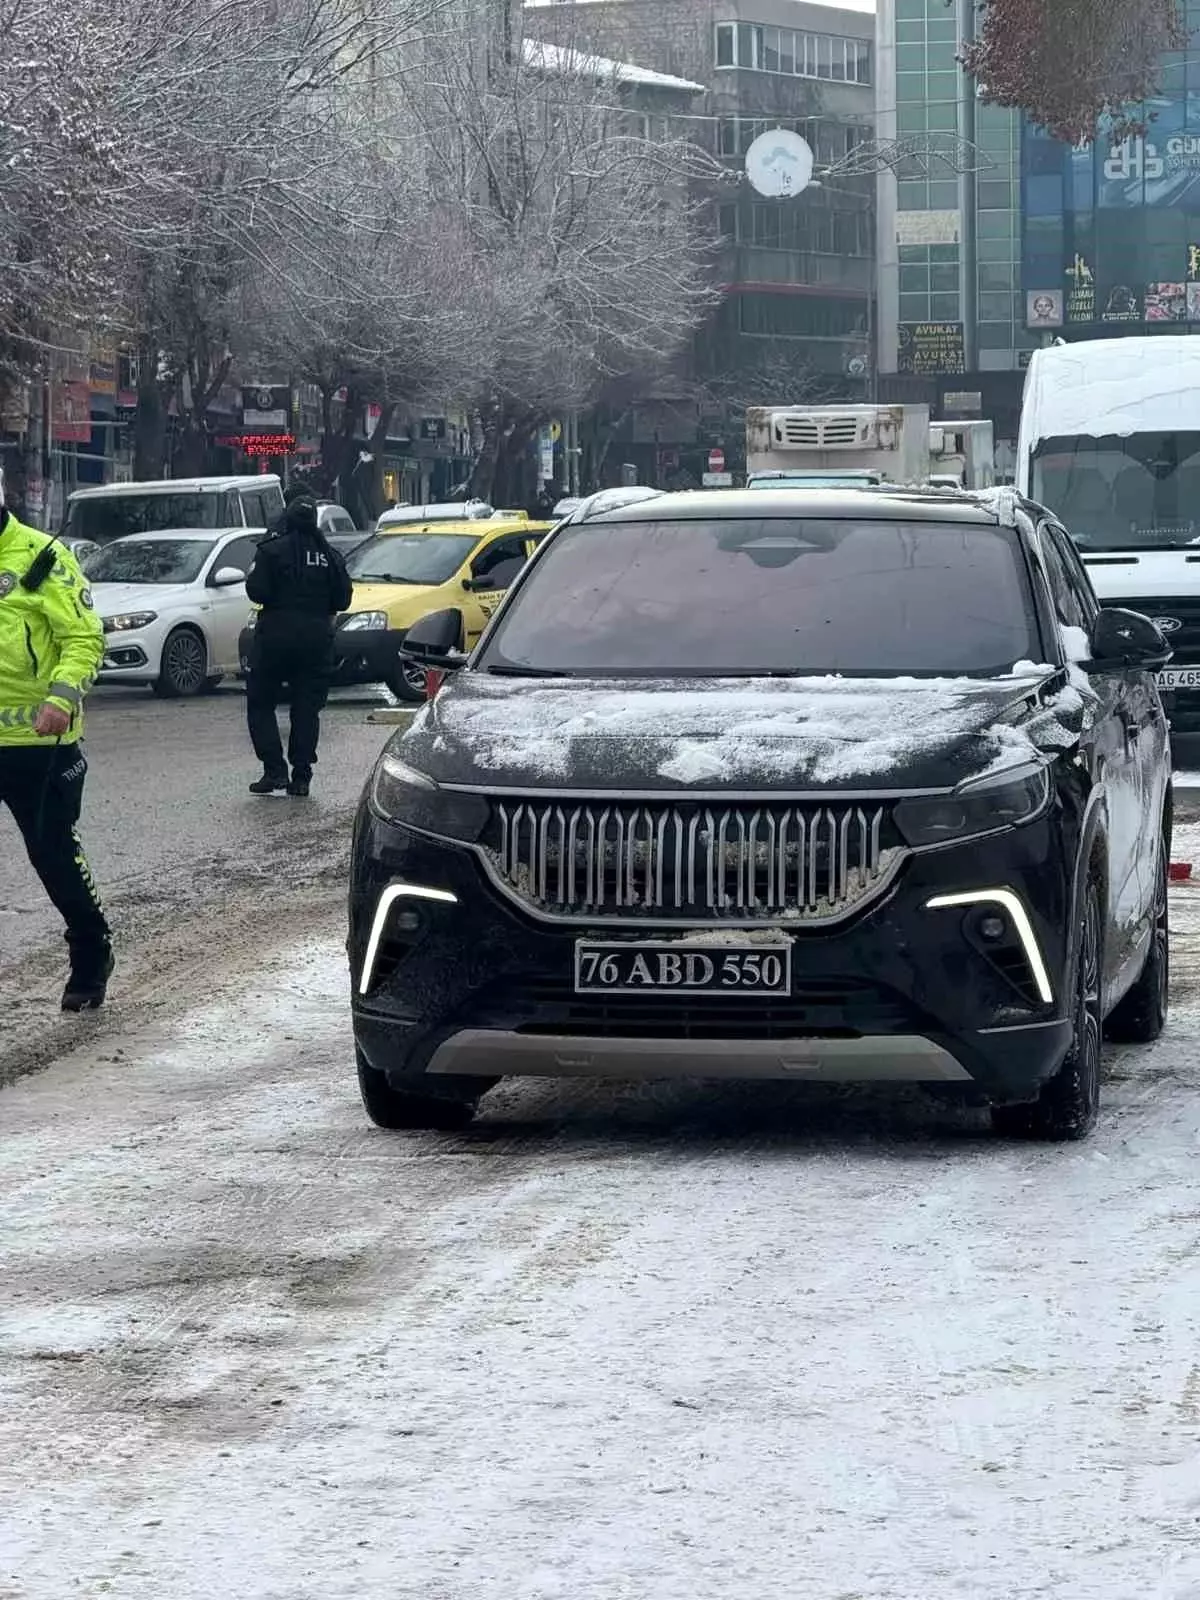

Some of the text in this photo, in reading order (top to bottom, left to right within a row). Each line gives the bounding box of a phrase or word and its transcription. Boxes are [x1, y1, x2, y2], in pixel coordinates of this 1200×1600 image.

[915, 324, 958, 335] AVUKAT
[914, 350, 963, 360] AVUKAT
[582, 952, 782, 987] 76 ABD 550
